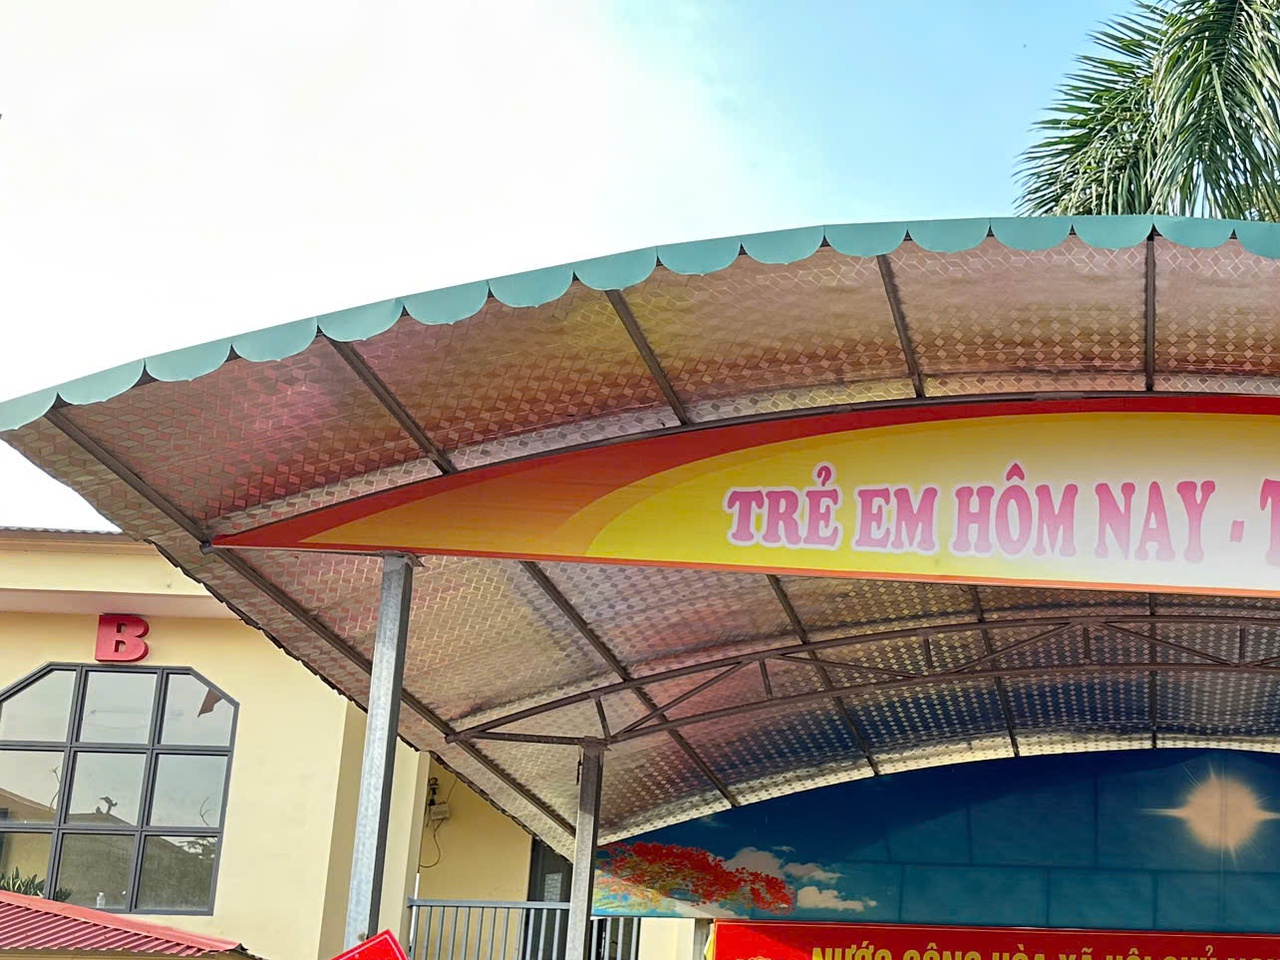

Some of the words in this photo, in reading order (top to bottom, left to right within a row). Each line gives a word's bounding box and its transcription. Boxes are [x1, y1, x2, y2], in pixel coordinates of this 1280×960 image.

[728, 465, 838, 544] TRẺ
[855, 487, 938, 551] EM
[953, 462, 1078, 556] HÔM
[1095, 481, 1215, 563] NAY
[95, 613, 149, 662] B
